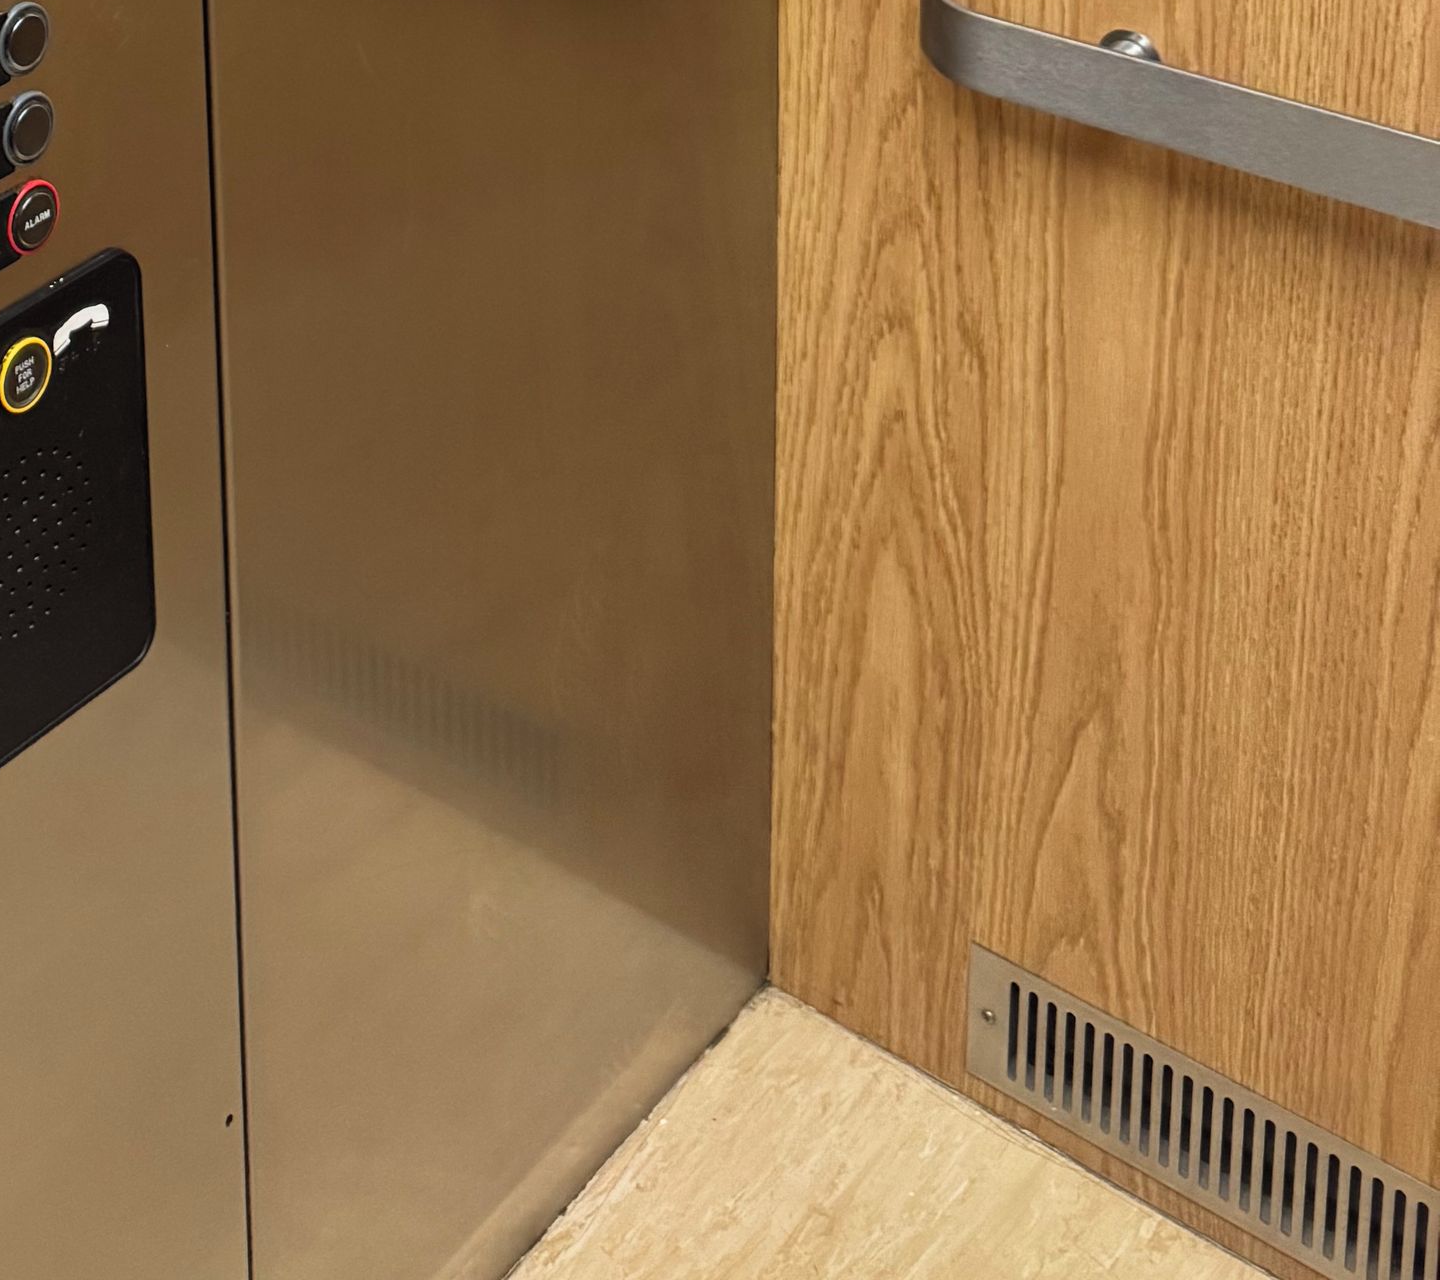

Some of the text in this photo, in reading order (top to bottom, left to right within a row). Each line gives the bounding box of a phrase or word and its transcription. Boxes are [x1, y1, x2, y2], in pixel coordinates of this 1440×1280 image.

[24, 209, 51, 231] ALARM
[15, 356, 34, 375] PUSH
[18, 368, 33, 383] FOR
[16, 376, 35, 395] HELP
